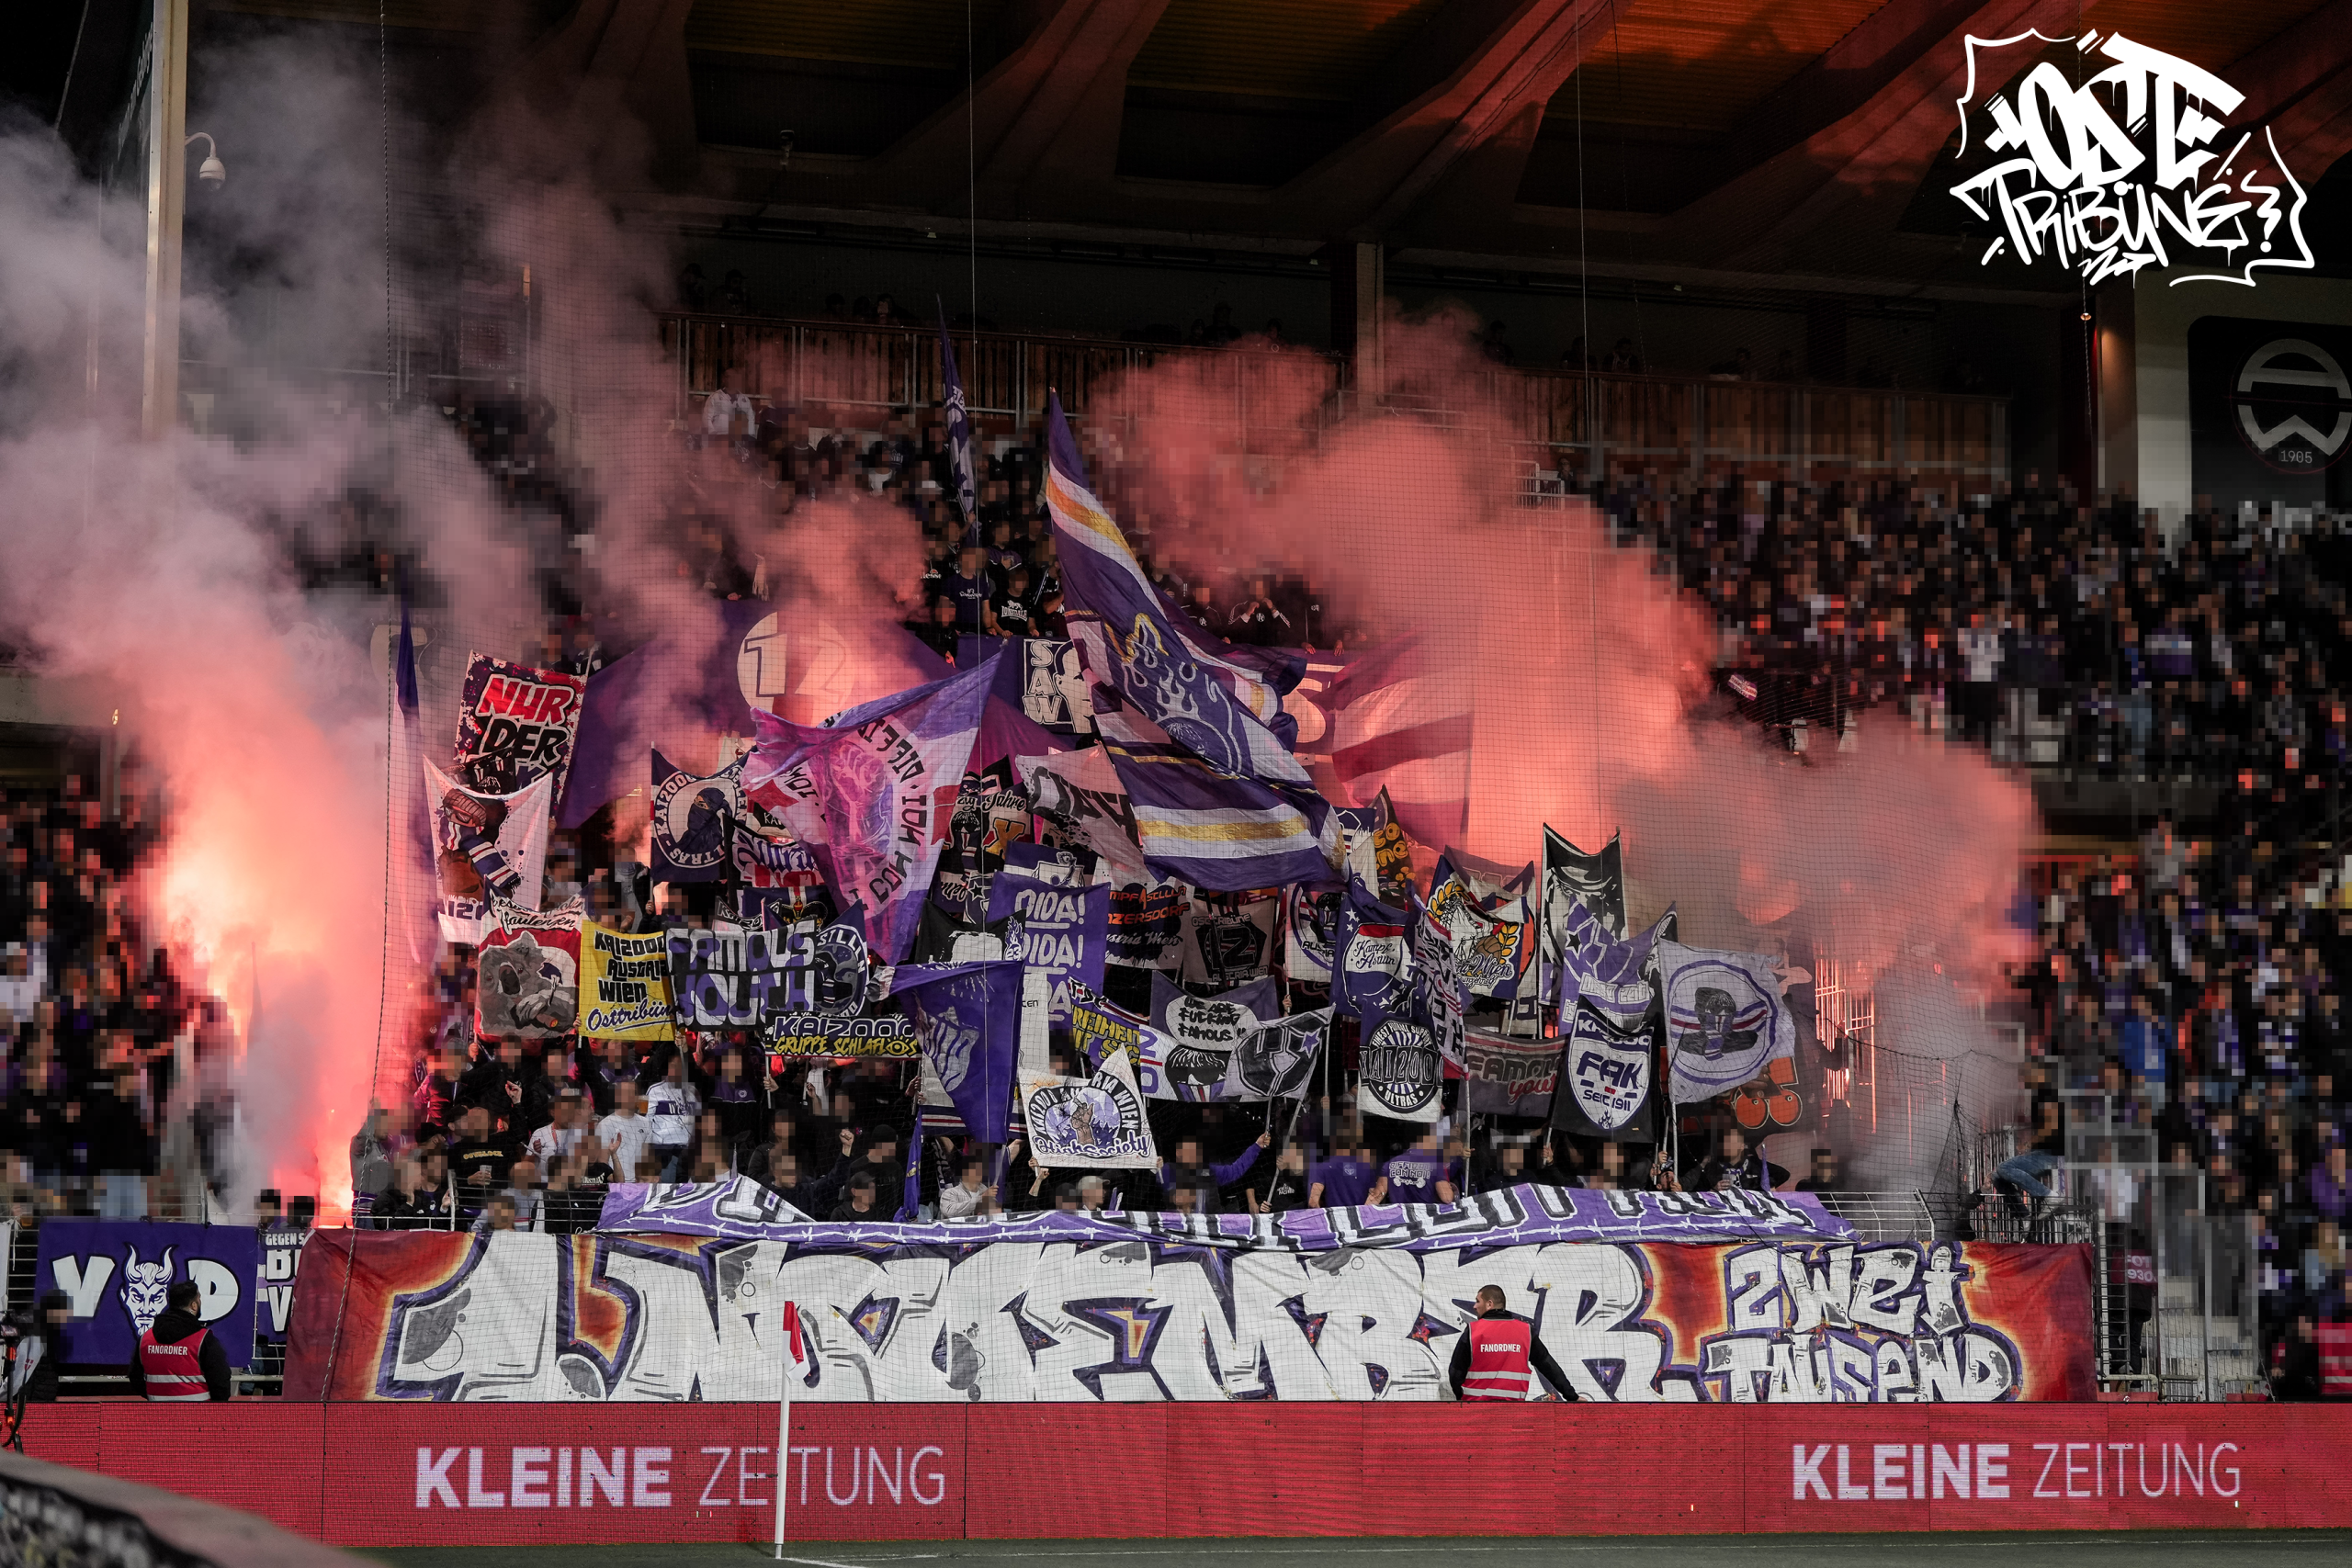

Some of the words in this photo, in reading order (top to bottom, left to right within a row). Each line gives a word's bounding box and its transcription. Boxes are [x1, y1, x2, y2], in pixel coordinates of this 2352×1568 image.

[1001, 605, 1028, 622] LONSDALE
[475, 673, 575, 727] NUR
[480, 716, 571, 766] DER
[1108, 902, 1190, 925] NZERSDORF
[666, 919, 815, 972] FAMOUS
[1472, 953, 1512, 977] Wien
[674, 970, 815, 1026] YOUTH
[1184, 997, 1206, 1010] WE
[1209, 1001, 1236, 1013] ARE
[587, 998, 673, 1032] Osttribün
[1071, 1005, 1140, 1045] REIHEIT
[775, 1036, 828, 1055] GRUPPE
[1577, 1051, 1643, 1089] FAK
[1385, 1091, 1419, 1107] ULTRAS
[1611, 1096, 1631, 1112] 1911
[266, 1233, 297, 1246] GEGEN
[147, 1344, 188, 1357] FANORDNER
[1479, 1343, 1521, 1355] FANORDNER
[415, 1447, 673, 1508] KLEINE
[698, 1445, 945, 1508] ZETUNG
[1792, 1444, 2011, 1501] KLEINE
[2032, 1442, 2242, 1499] ZEITUNG
